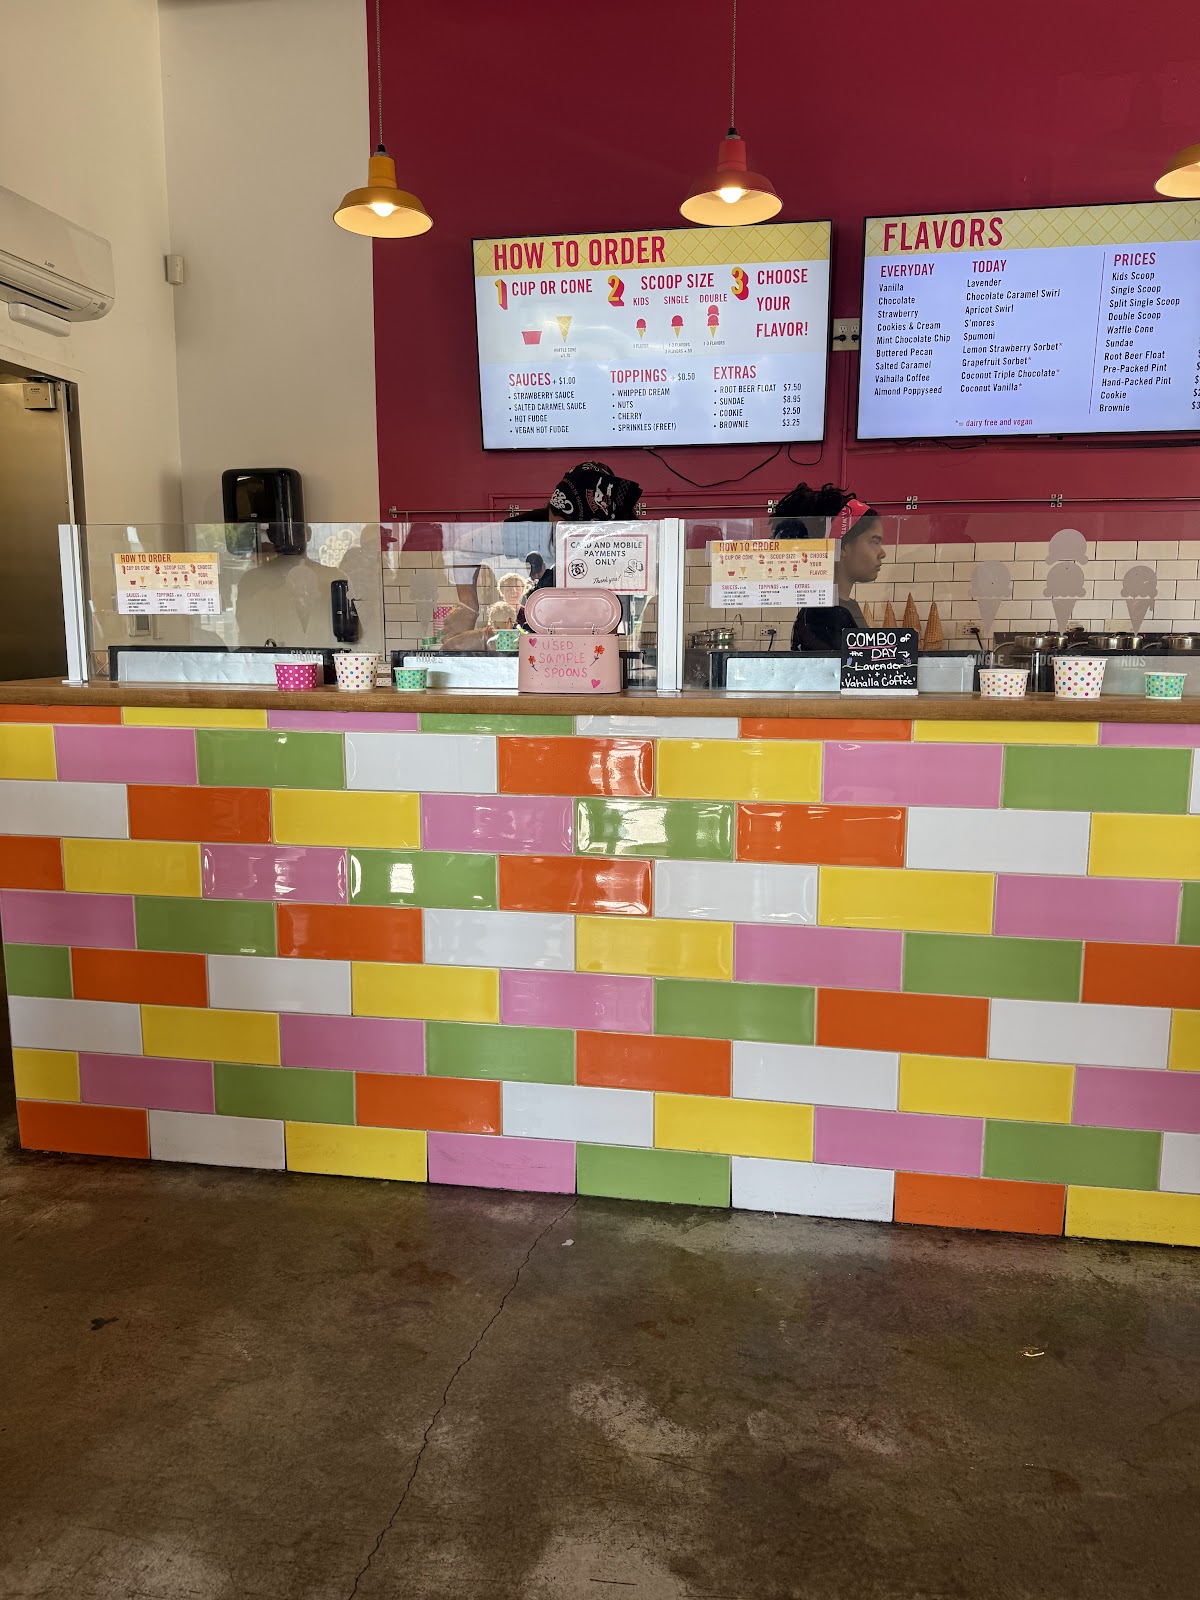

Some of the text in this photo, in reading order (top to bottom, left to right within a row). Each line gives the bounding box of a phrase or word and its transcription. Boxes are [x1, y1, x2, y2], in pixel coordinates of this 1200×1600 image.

[883, 217, 1003, 251] FLAVORS
[494, 236, 665, 270] HOW TO ORDER
[1114, 252, 1156, 266] PRICES
[880, 260, 1007, 278] EVERYDAY TODAY
[1112, 272, 1155, 281] Kids Scoop
[512, 282, 536, 296] CUP
[540, 280, 557, 295] OR
[561, 279, 592, 294] CONE
[731, 267, 808, 301] 3 CHOOSE
[879, 283, 904, 292] Vanilla
[967, 278, 1001, 288] Lavender
[608, 273, 714, 307] 2 SCOOP SIZE
[966, 289, 1060, 301] Chocolate Caramel Swirl
[1111, 285, 1161, 295] Single Scoop
[633, 296, 649, 306] KIDS
[664, 295, 689, 304] SINGLE
[699, 294, 727, 303] DOUBLE
[878, 296, 915, 305] Chocolate
[1109, 298, 1180, 309] Split Single Scoop
[757, 297, 790, 311] YOUR
[878, 309, 918, 320] Strawberry
[965, 304, 1014, 315] Apricot Swirl
[1109, 312, 1161, 321] Double Scoop
[877, 321, 941, 331] Cookies & Cream
[964, 319, 995, 328] S'mores
[756, 322, 808, 337] FLAVOR!
[1107, 326, 1132, 334] Waffle
[876, 334, 951, 344] Mint Chocolate Chip
[963, 332, 995, 342] Spumoni
[876, 348, 933, 357] Buttered Pecan
[963, 345, 988, 354] Lemon
[990, 344, 1031, 354] Strawberry
[1125, 352, 1143, 360] Beer
[1145, 351, 1165, 359] Float
[875, 360, 931, 371] Salted Caramel
[962, 358, 1001, 369] Grapefruit
[1103, 364, 1167, 373] Pre-Packed Pint
[611, 369, 667, 383] TOPPINGS
[677, 372, 695, 381] $0.50
[713, 365, 756, 380] EXTRAS
[961, 371, 991, 380] Coconut
[994, 370, 1016, 380] Triple
[509, 373, 551, 387] SAUCES
[558, 376, 576, 385] $1.00
[875, 374, 930, 383] Valhalla Coffee
[1102, 377, 1171, 386] Hand-Packed Pint
[618, 387, 670, 397] WHIPPED CREAM
[720, 383, 801, 393] ROOT BEER FLOAT $7.50
[874, 386, 942, 397] Almond Poppyseed
[960, 384, 991, 392] Coconut
[514, 391, 574, 400] STRAWBERRY SAUCE
[1101, 391, 1126, 399] Cookie
[514, 401, 586, 411] SALTED CARAMEL SAUCE
[618, 400, 633, 409] NUTS
[719, 397, 744, 405] SUNDAE
[719, 407, 800, 417] COOKIE $2.50
[1100, 404, 1130, 412] Brownie
[514, 415, 547, 423] HOT FUDGE
[618, 412, 642, 420] CHERRY
[618, 422, 676, 431] SPRINKLES (FREE!)
[719, 419, 800, 428] BROWNIE $3.25
[966, 419, 982, 428] dairy
[984, 418, 997, 426] free
[1000, 418, 1012, 426] and
[1014, 418, 1033, 427] vegan
[515, 426, 534, 434] VEGAN
[550, 425, 569, 433] FUDGE
[720, 542, 779, 551] HOW TO ORDER
[149, 554, 171, 562] ORDER
[847, 632, 911, 647] COMBO of
[541, 641, 573, 650] USED
[416, 652, 435, 662] KIDS
[871, 647, 897, 659] DAY
[1121, 655, 1146, 667] KIDS
[855, 662, 903, 671] Lavender
[544, 668, 587, 677] SPOONS
[882, 675, 913, 686] Coffee
